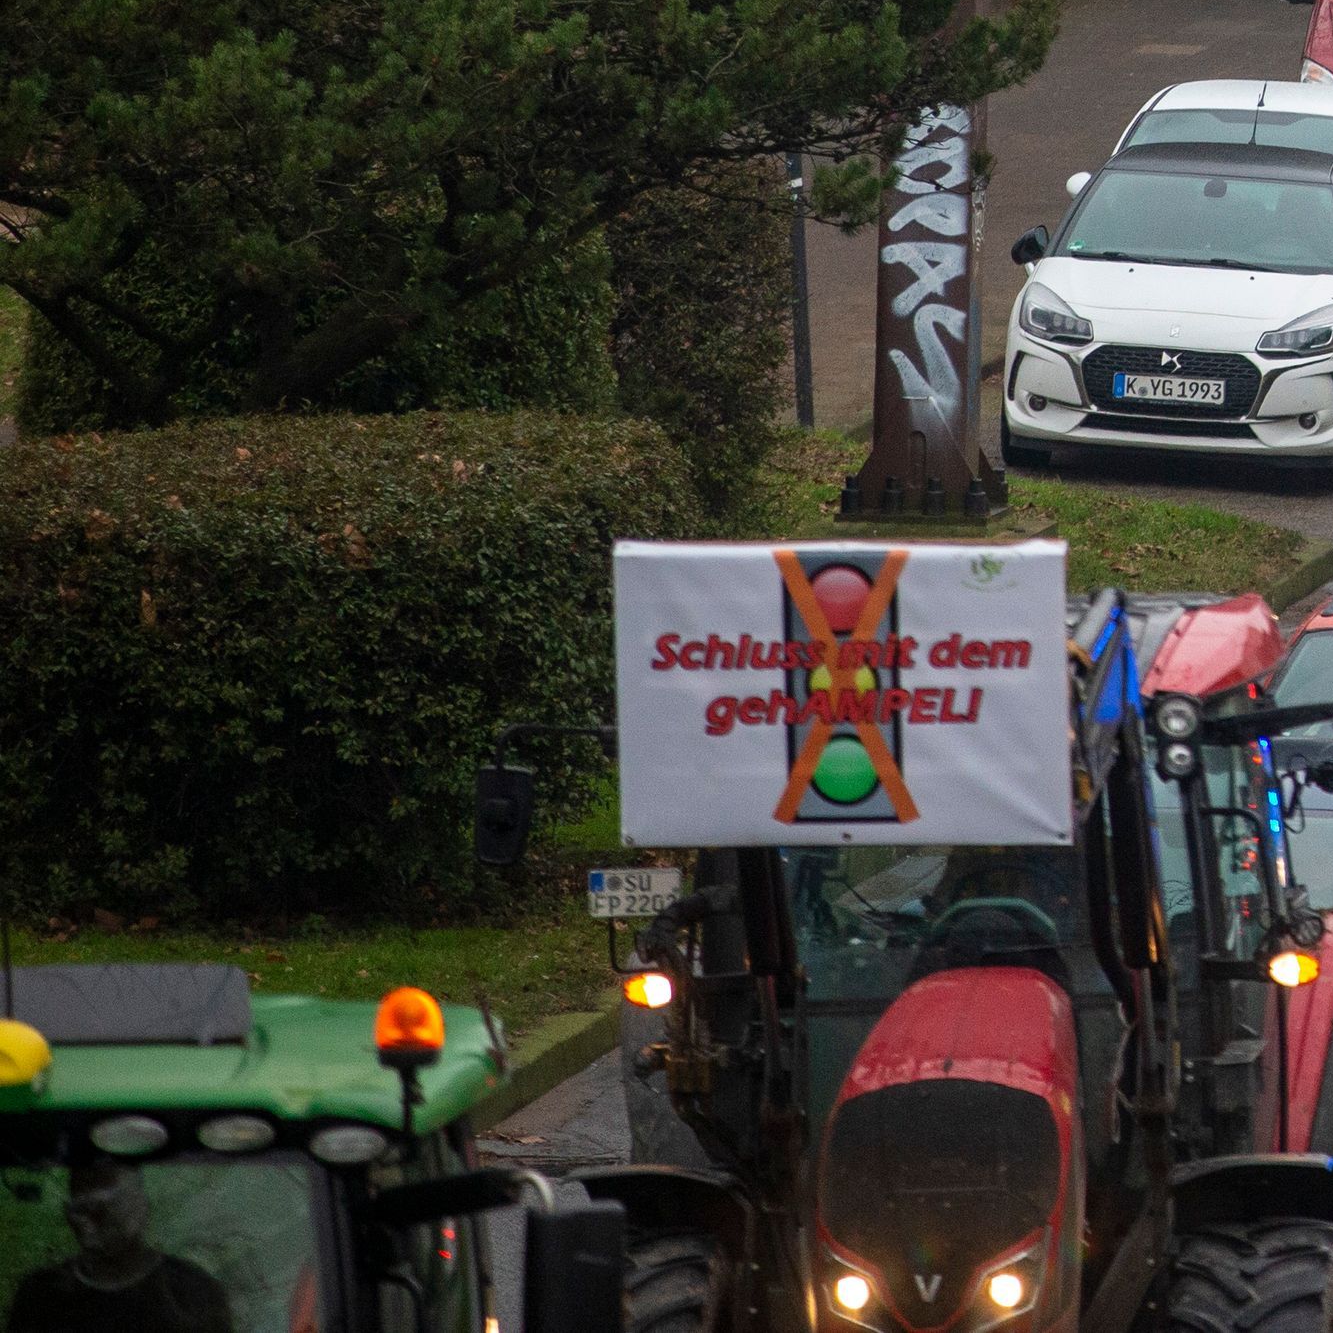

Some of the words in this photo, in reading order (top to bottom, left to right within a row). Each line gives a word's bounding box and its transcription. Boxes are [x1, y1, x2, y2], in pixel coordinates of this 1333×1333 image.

[1126, 377, 1138, 395] K
[652, 633, 828, 670] Schluss
[841, 631, 919, 669] mit
[928, 632, 1032, 669] dem
